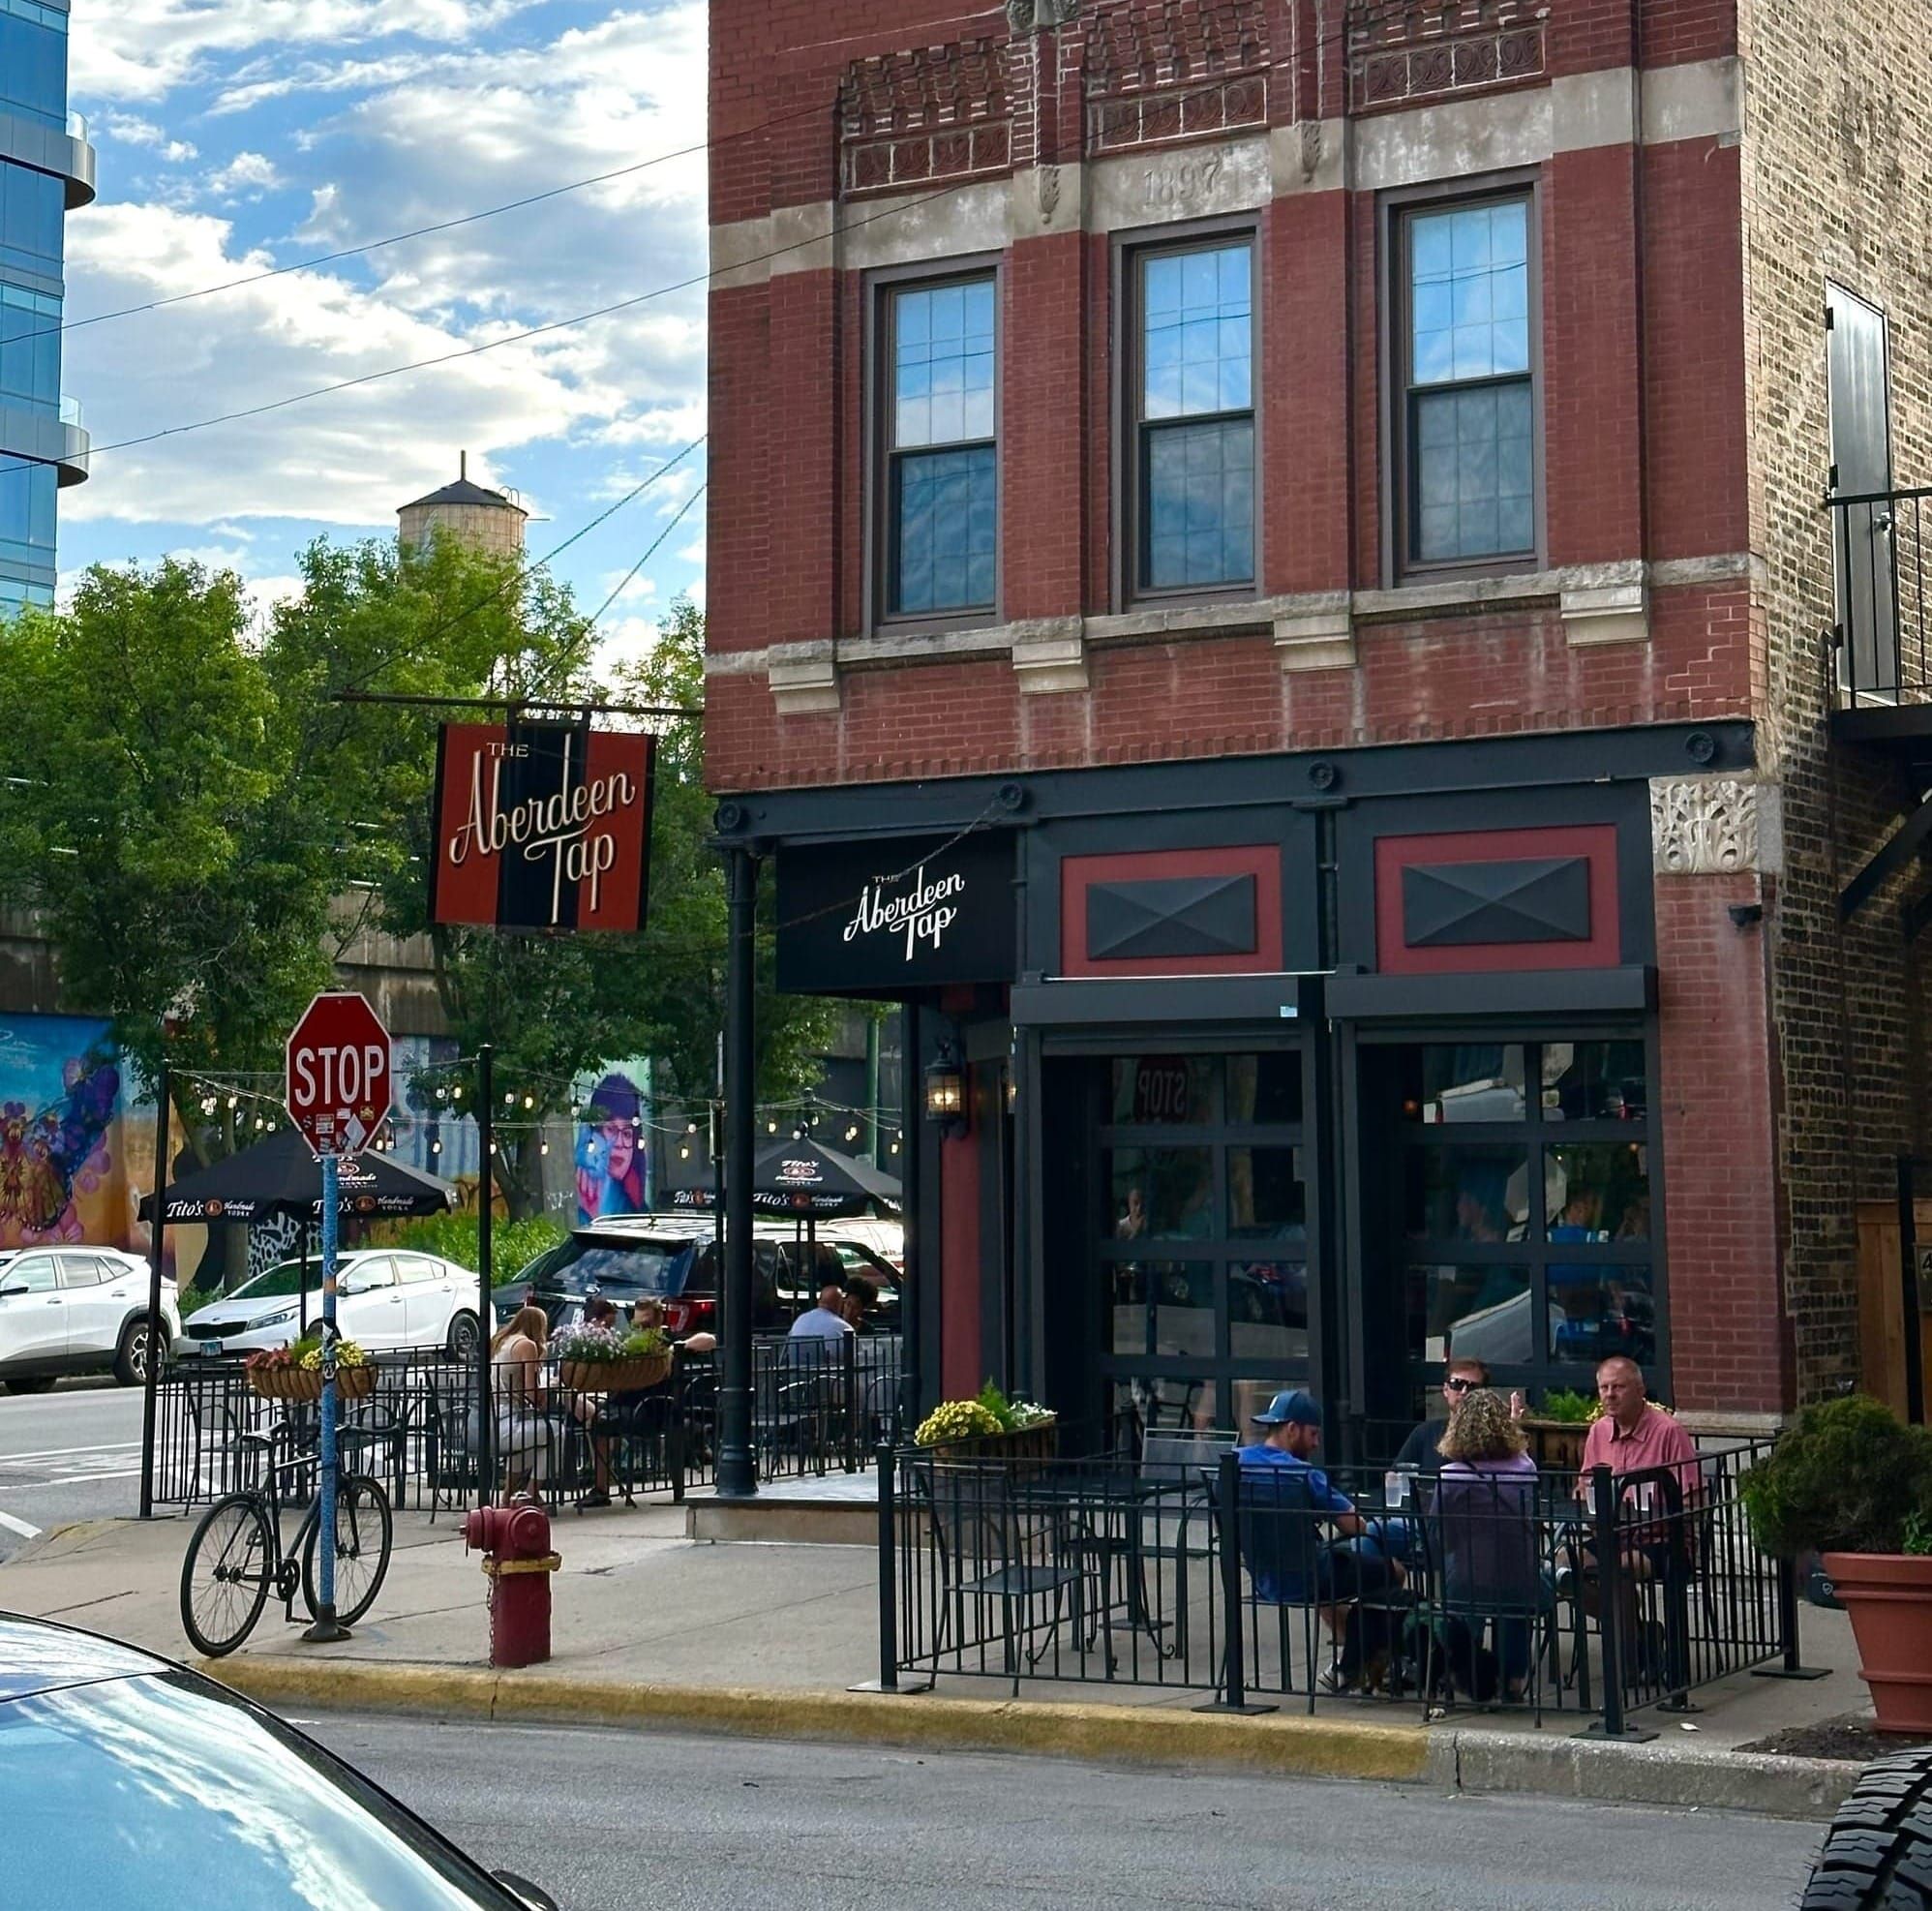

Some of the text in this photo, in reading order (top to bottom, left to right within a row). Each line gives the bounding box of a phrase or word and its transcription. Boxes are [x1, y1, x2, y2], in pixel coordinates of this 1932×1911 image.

[1143, 160, 1221, 208] 1897
[486, 742, 529, 758] THE
[449, 733, 636, 864] Aberdeen
[524, 820, 615, 925] Tap
[871, 874, 899, 884] THE
[842, 864, 965, 942] Aberdeen
[889, 902, 957, 961] Tap
[294, 1045, 385, 1107] STOP
[166, 1199, 205, 1218] Tito's
[312, 1196, 354, 1215] To's
[752, 1192, 791, 1206] Tito's
